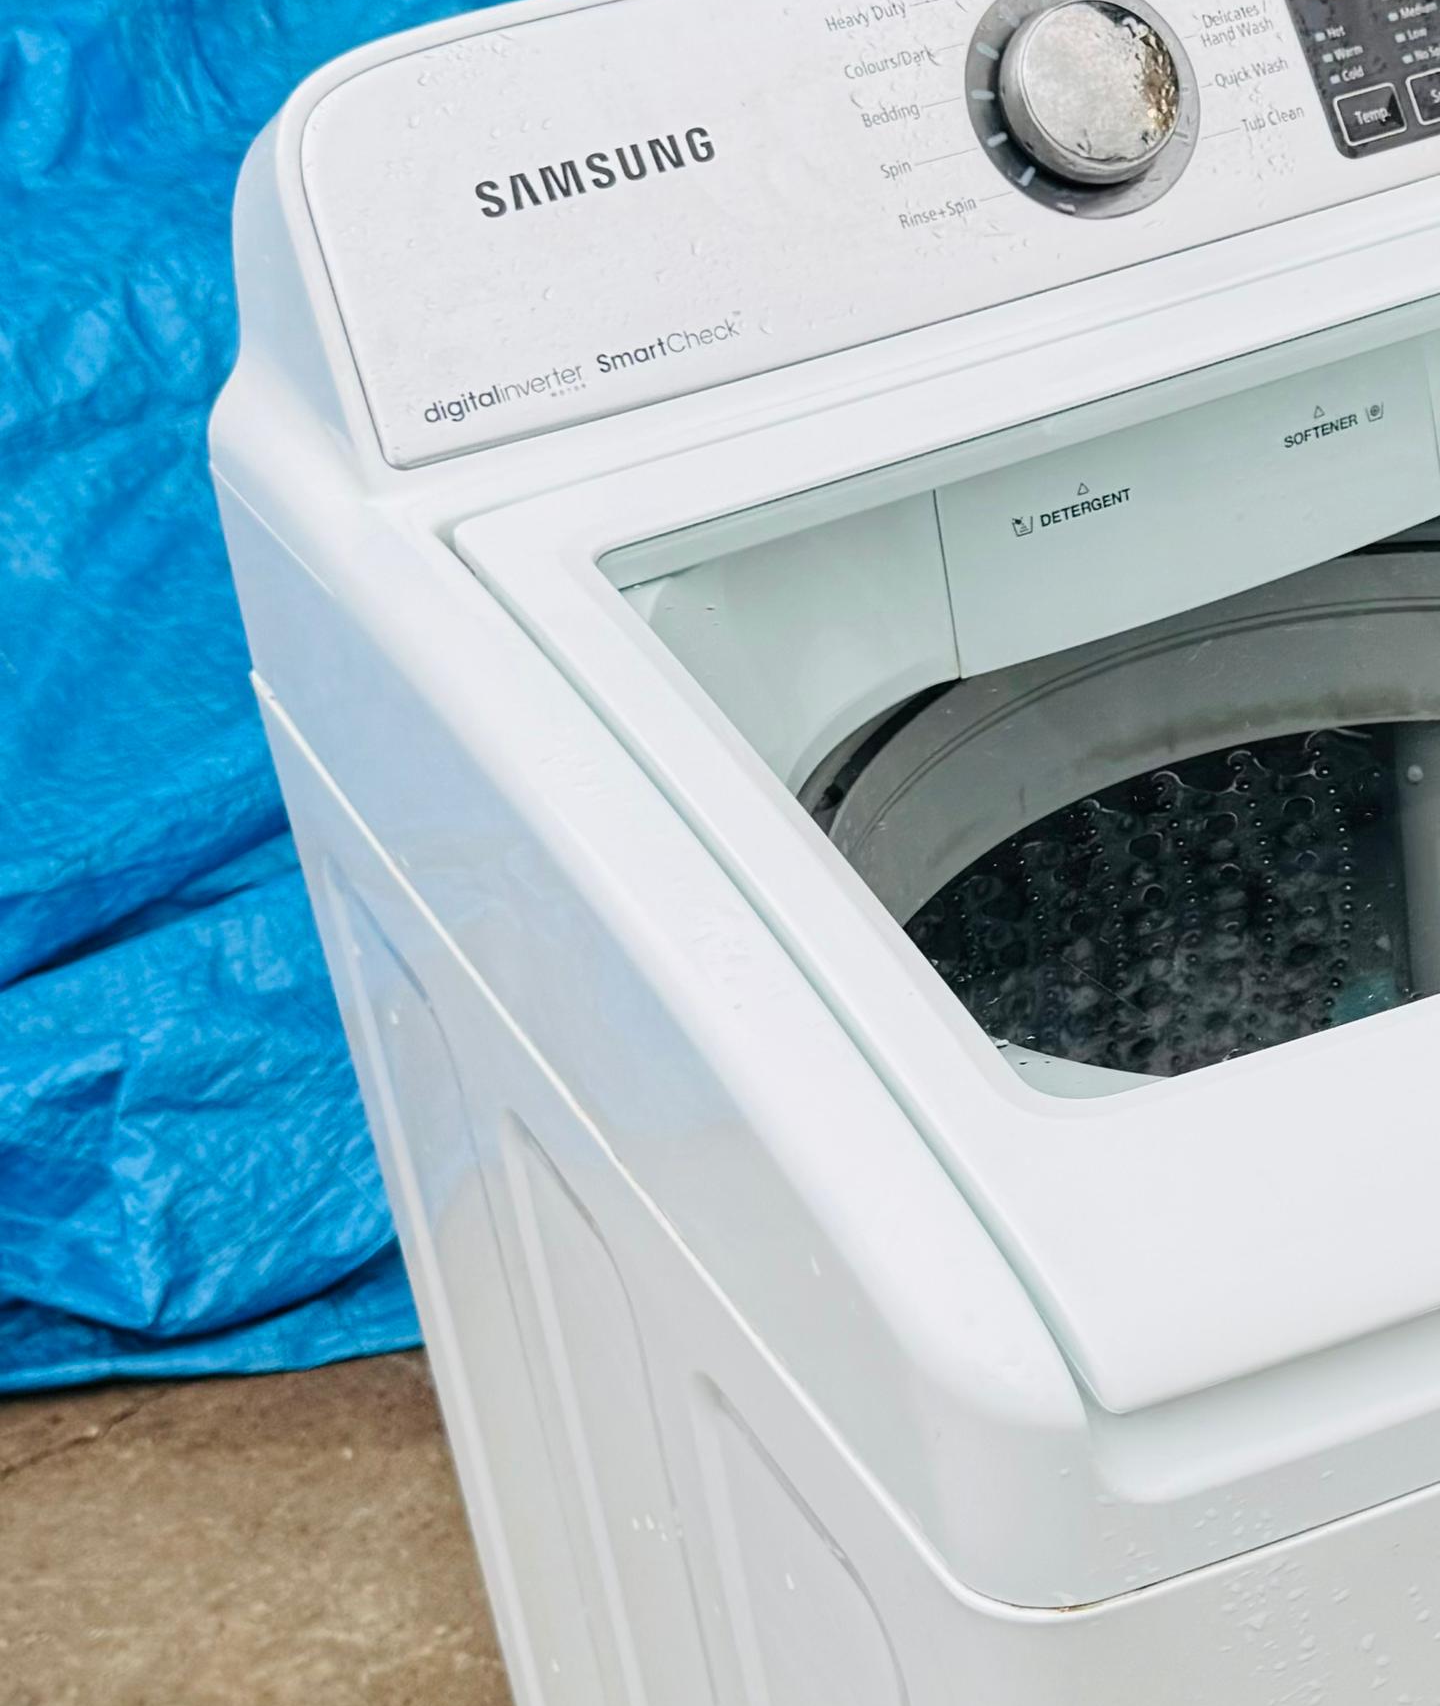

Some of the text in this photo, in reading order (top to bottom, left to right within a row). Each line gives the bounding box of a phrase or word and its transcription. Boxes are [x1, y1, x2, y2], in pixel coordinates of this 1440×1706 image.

[824, 1, 907, 31] Heavy Duty
[1400, 2, 1438, 19] Medium
[1200, 17, 1274, 47] Hand Wash
[1326, 26, 1346, 39] Hot
[1407, 28, 1428, 41] Low
[843, 45, 936, 79] Colours/Dark
[1333, 45, 1364, 61] Warm
[1215, 57, 1289, 89] Quick Wash
[1341, 65, 1365, 82] Cold
[861, 104, 921, 128] Bedding
[1242, 107, 1304, 133] Tub Clean
[1354, 106, 1391, 125] Temp.
[474, 127, 716, 218] SAMSUNG
[880, 160, 912, 181] Spin
[899, 197, 977, 229] Rinse+Spin
[596, 318, 740, 373] SmartCheck
[1284, 414, 1359, 449] SOFTENER
[1040, 488, 1132, 528] DETERGENT
